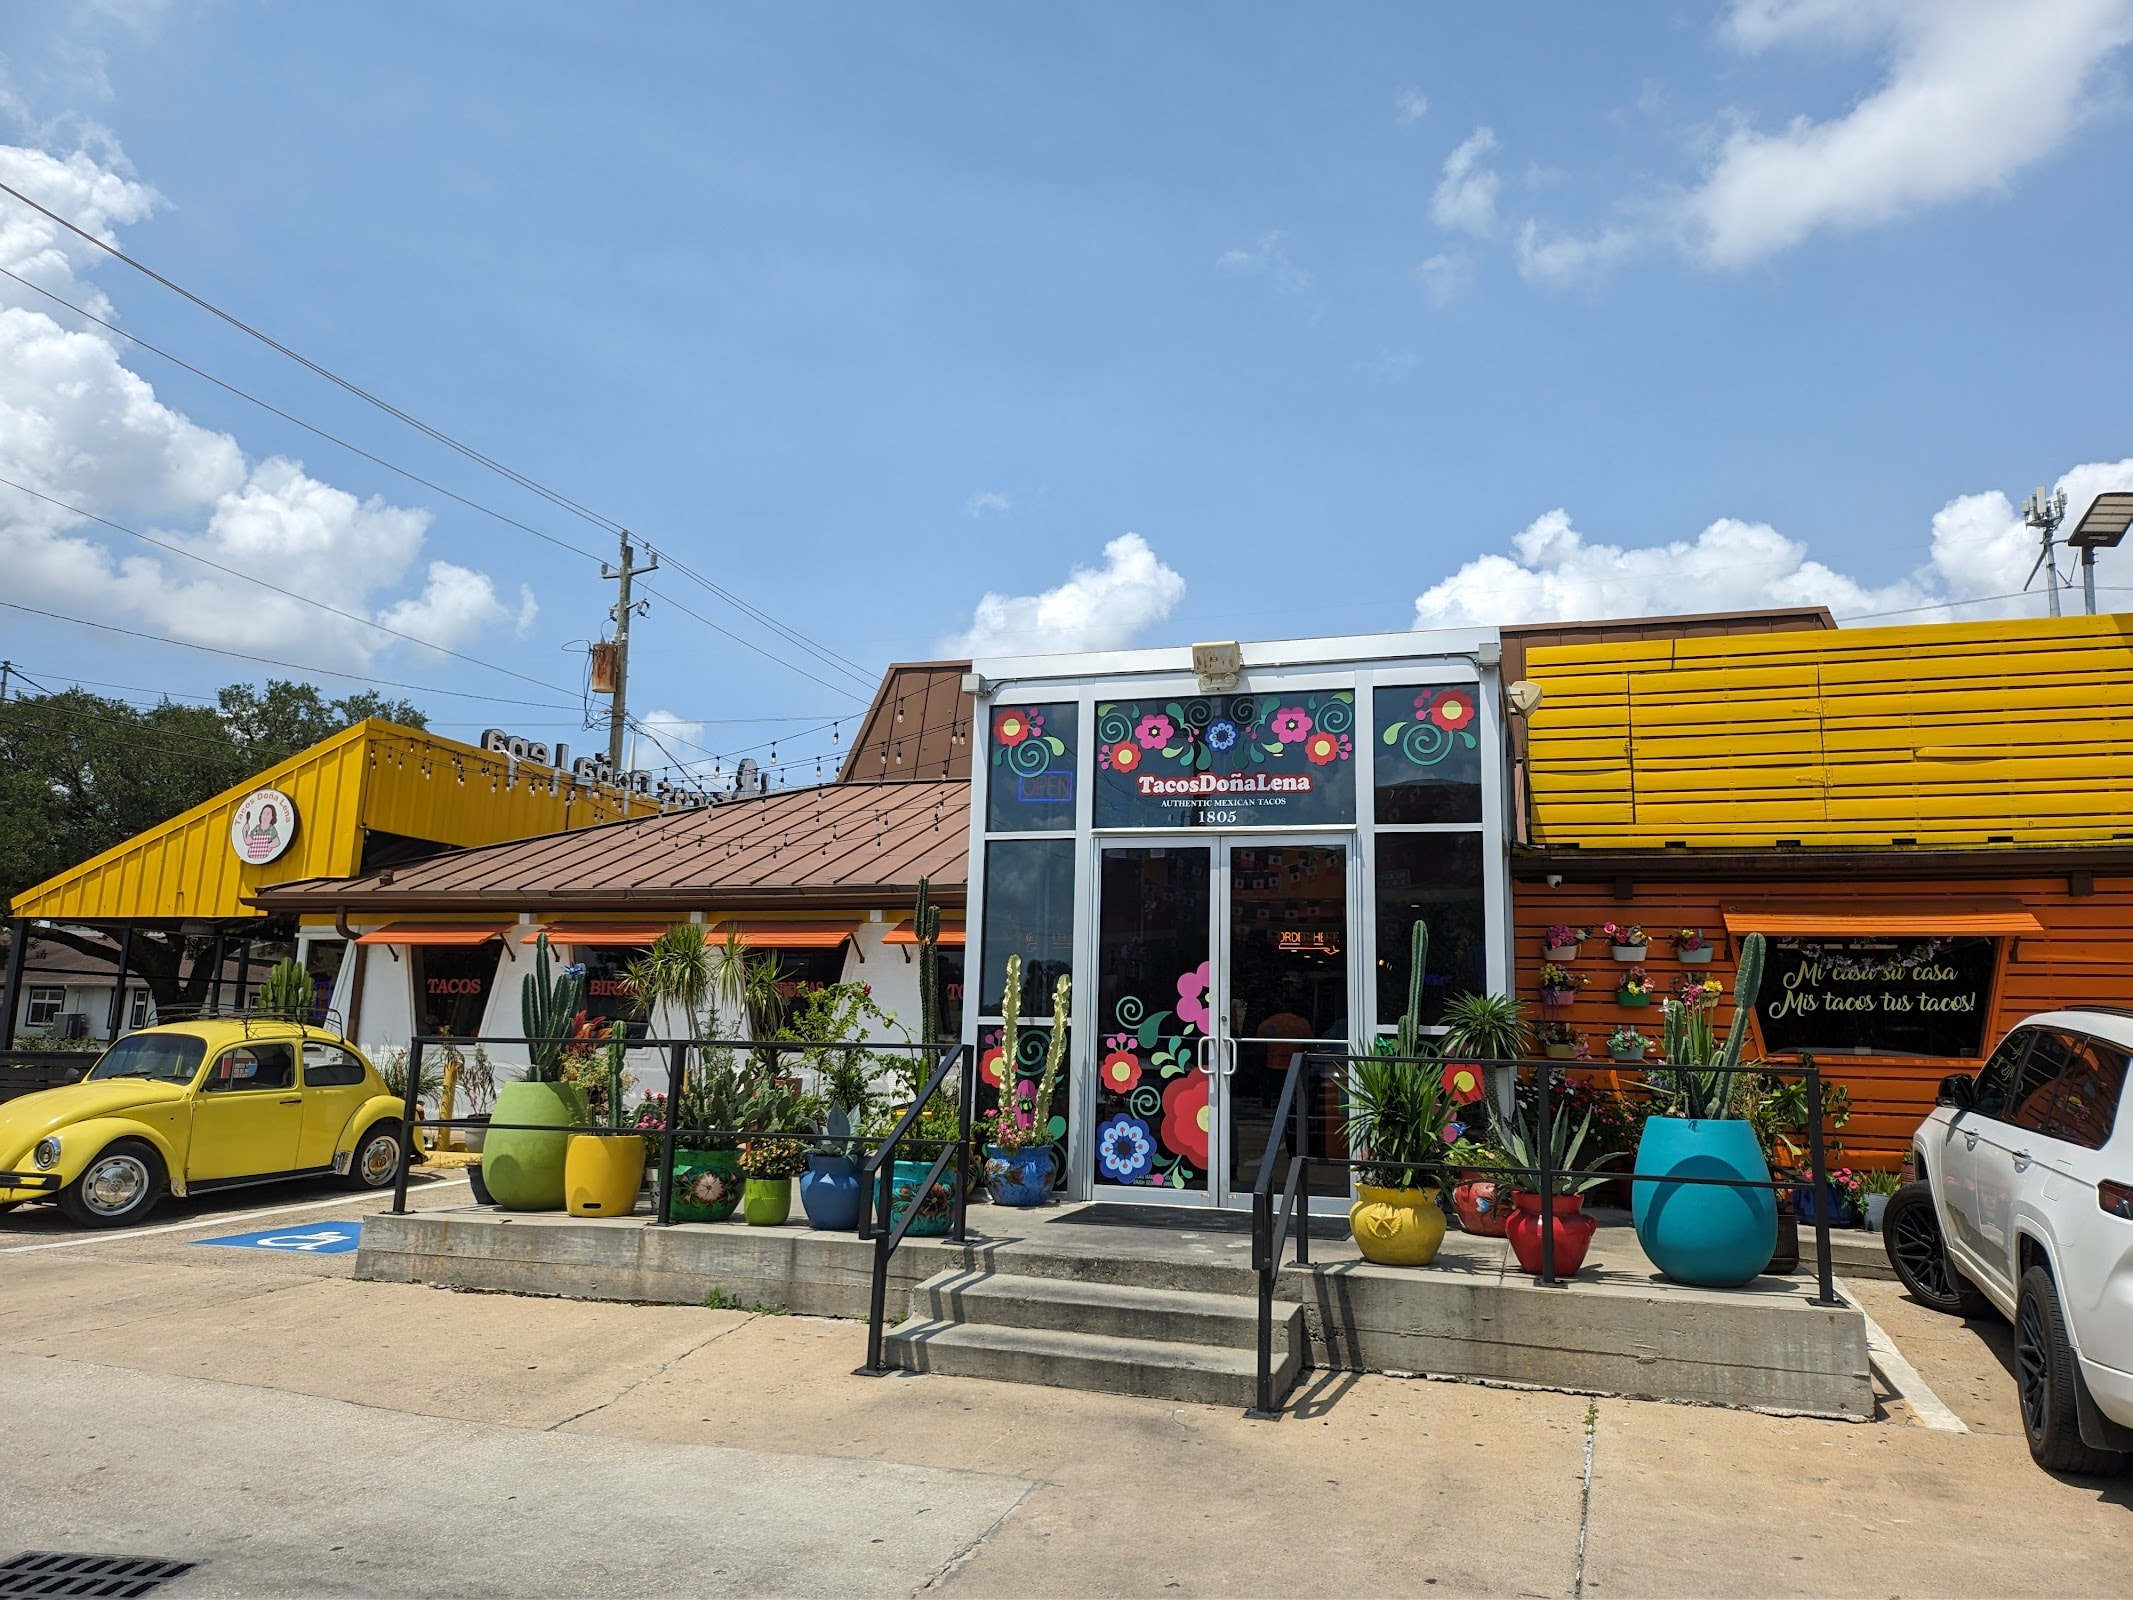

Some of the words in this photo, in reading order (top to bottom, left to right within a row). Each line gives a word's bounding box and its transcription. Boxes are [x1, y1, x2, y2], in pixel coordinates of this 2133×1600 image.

[1022, 775, 1070, 797] OPEN
[1138, 773, 1312, 795] TacosDoñaLena
[234, 798, 255, 826] Tacos
[257, 792, 279, 801] Doña
[279, 798, 291, 823] Lena
[1161, 800, 1212, 808] AUTHENTIC
[1214, 798, 1255, 807] MEXICAN
[1256, 797, 1287, 806] TACOS
[1198, 810, 1237, 823] 1805
[1782, 960, 1826, 989] Mi
[1832, 965, 1878, 981] casa
[1881, 965, 1906, 981] su
[1912, 964, 1959, 981] casa
[427, 978, 481, 994] TACOS
[1768, 989, 1820, 1019] Mis
[1821, 991, 1878, 1012] tacos
[1880, 991, 1914, 1012] tus
[1916, 991, 1976, 1012] tacos!
